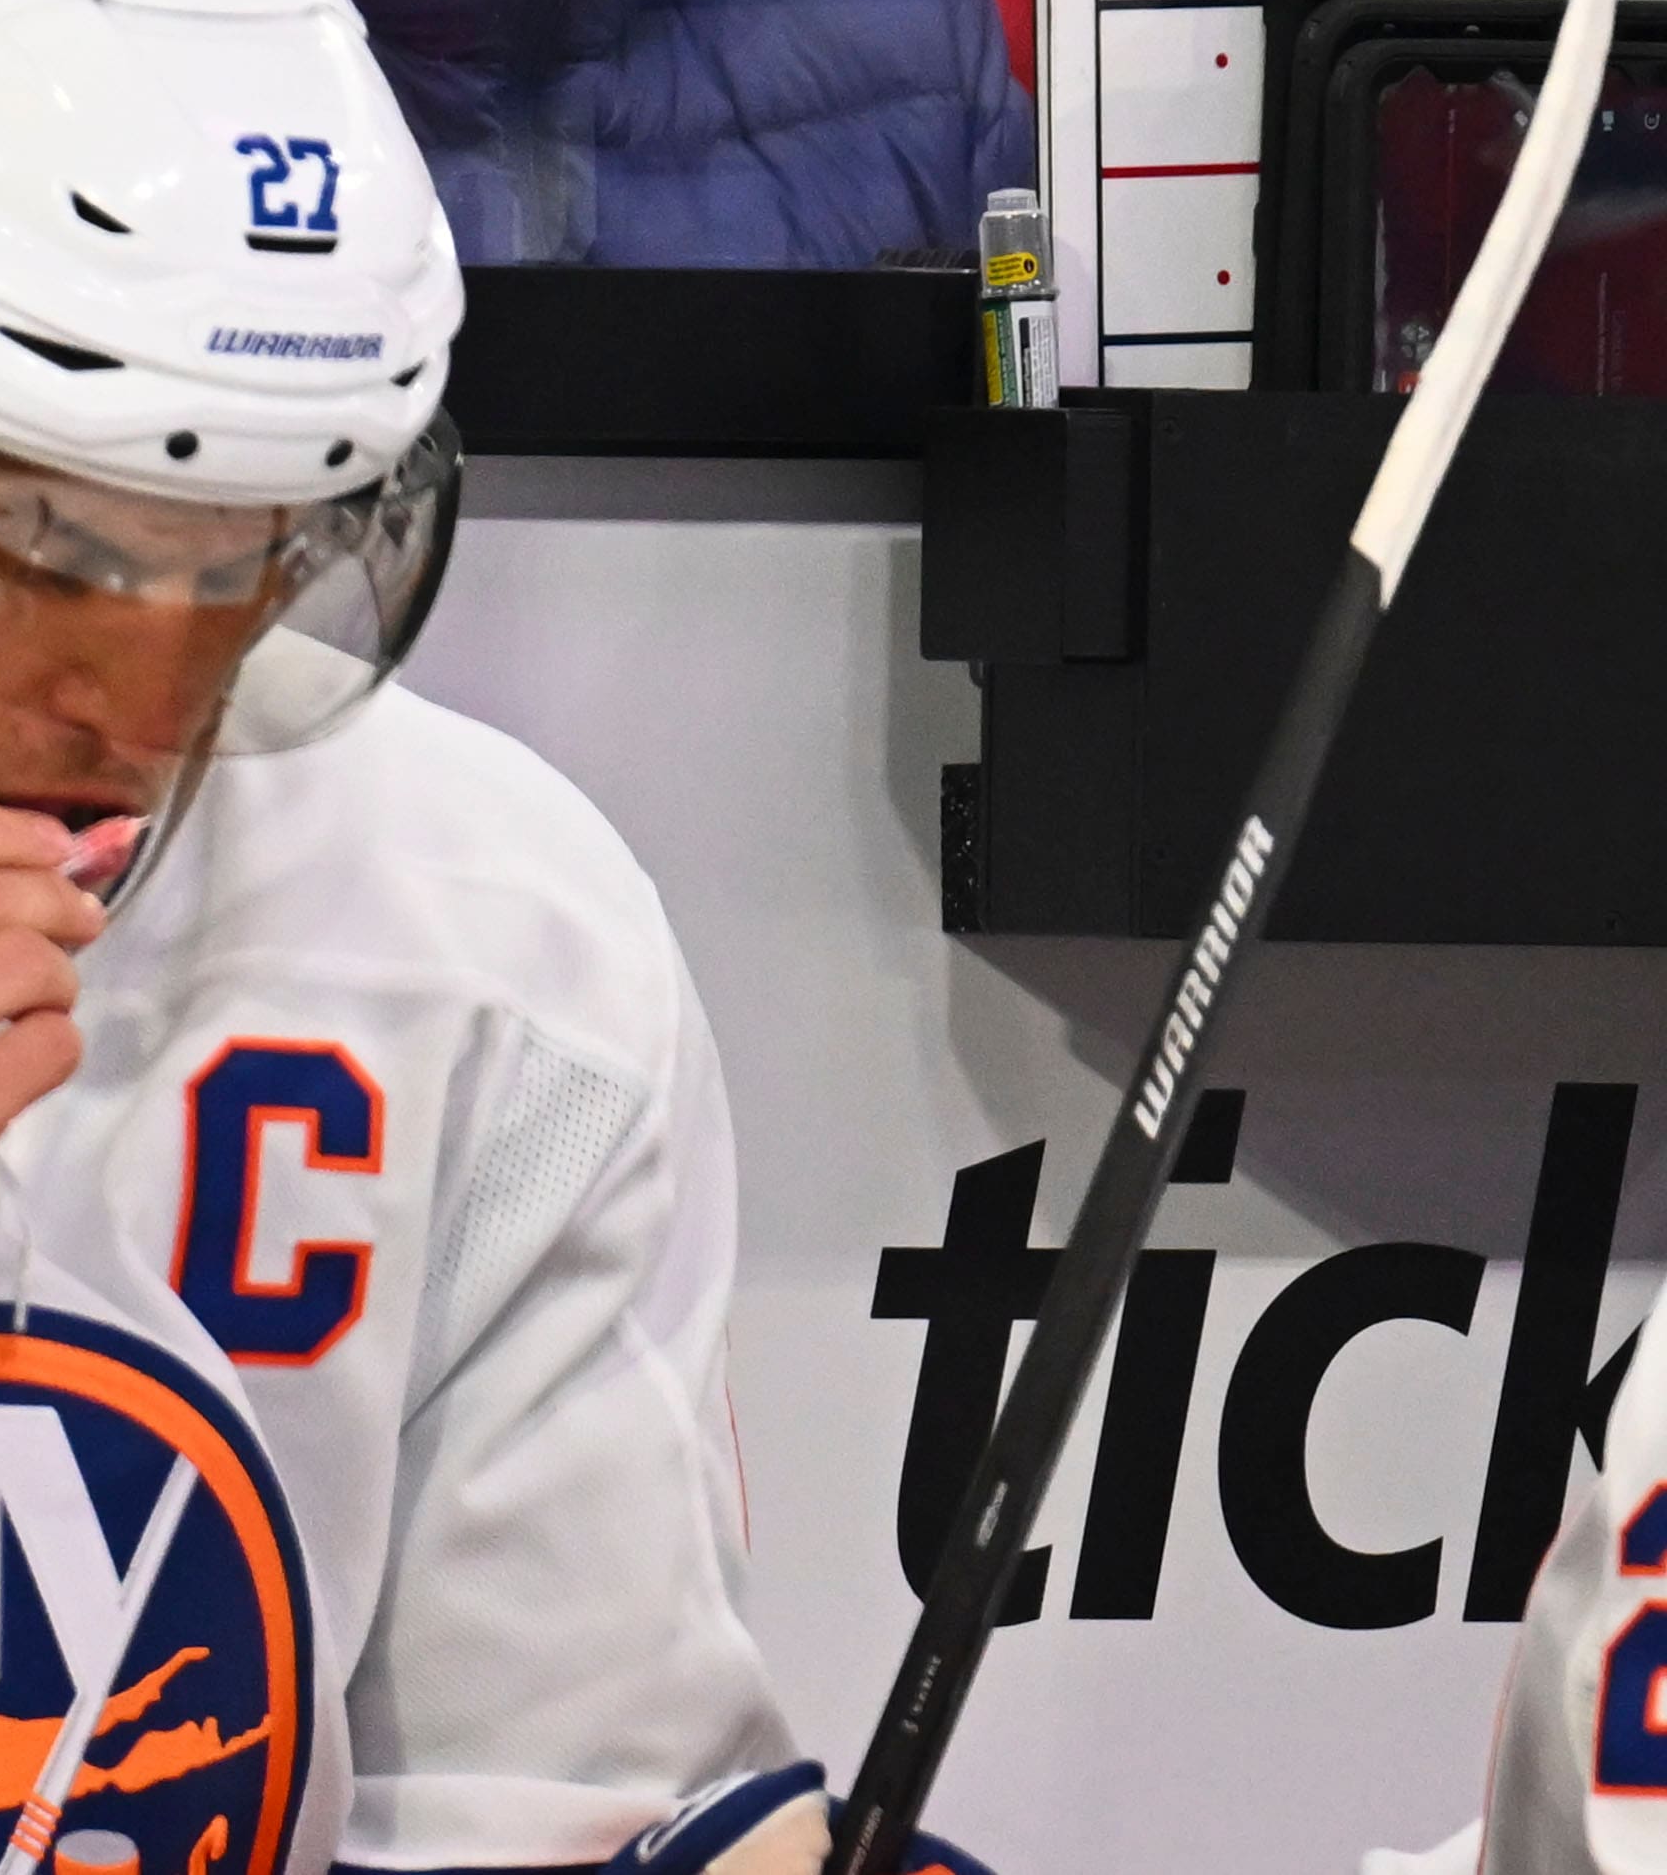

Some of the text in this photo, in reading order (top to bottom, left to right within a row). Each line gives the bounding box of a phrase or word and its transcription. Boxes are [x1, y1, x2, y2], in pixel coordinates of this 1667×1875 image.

[234, 135, 340, 232] 27
[1134, 815, 1274, 1140] WARRIOR
[169, 1035, 385, 1367] C
